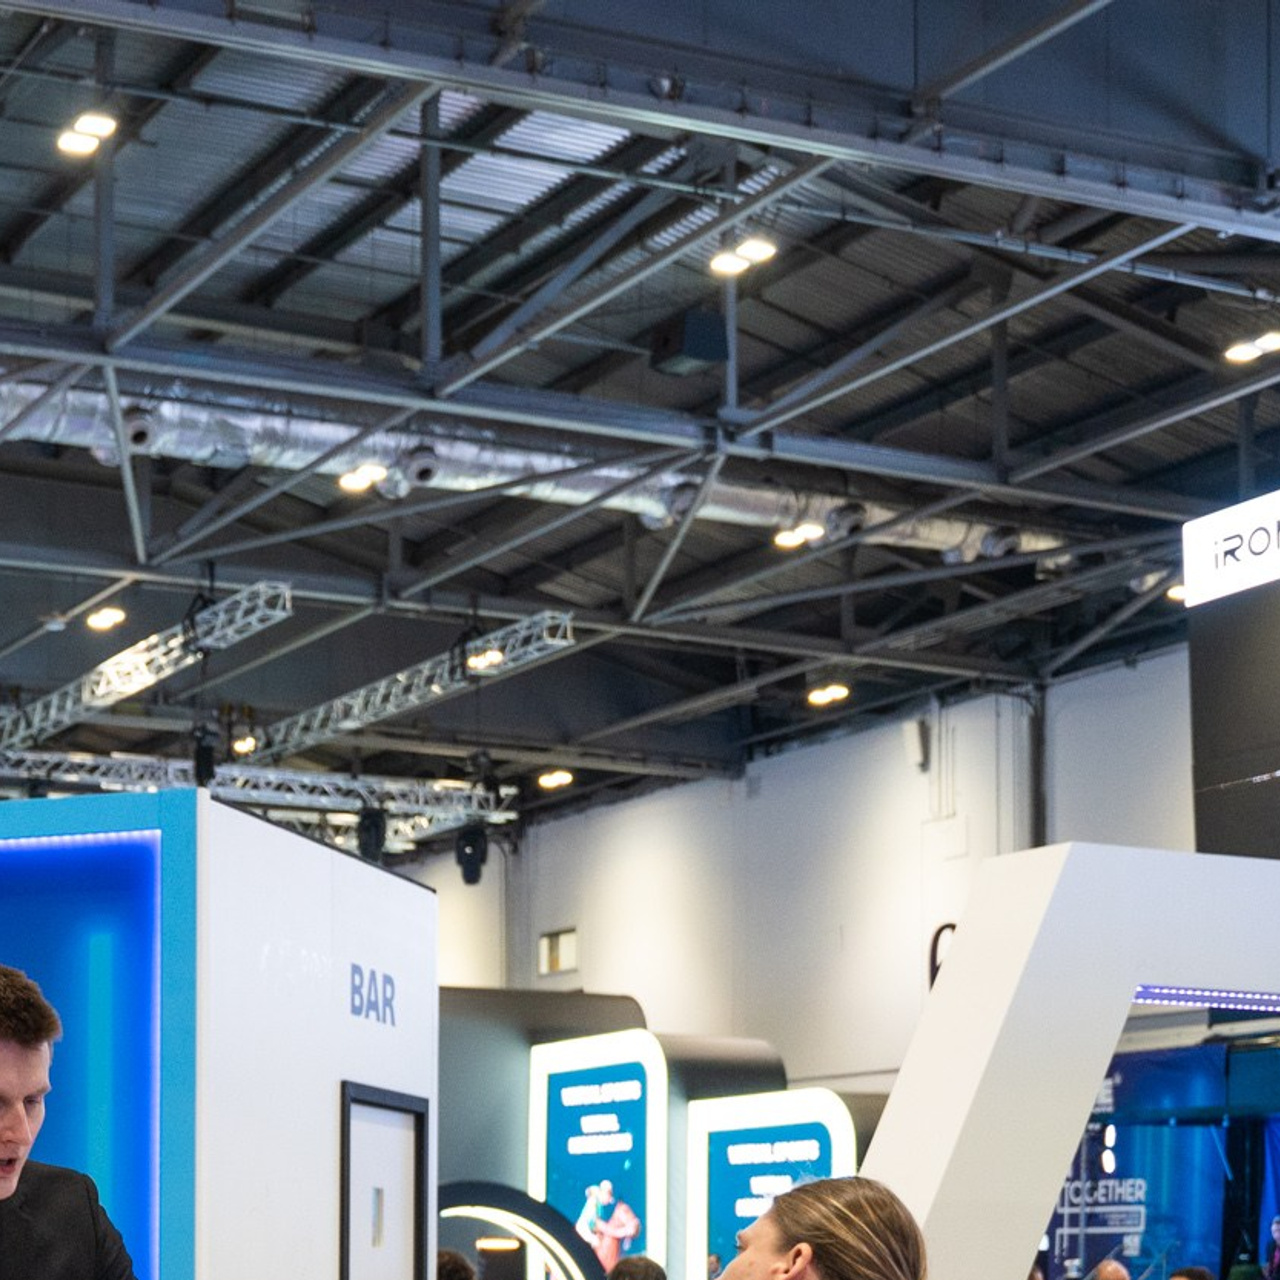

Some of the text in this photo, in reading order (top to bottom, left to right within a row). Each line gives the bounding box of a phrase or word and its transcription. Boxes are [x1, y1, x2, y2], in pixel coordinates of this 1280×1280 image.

[1214, 520, 1280, 569] iRO
[350, 962, 396, 1027] BAR
[1063, 1178, 1146, 1205] TOGETHER
